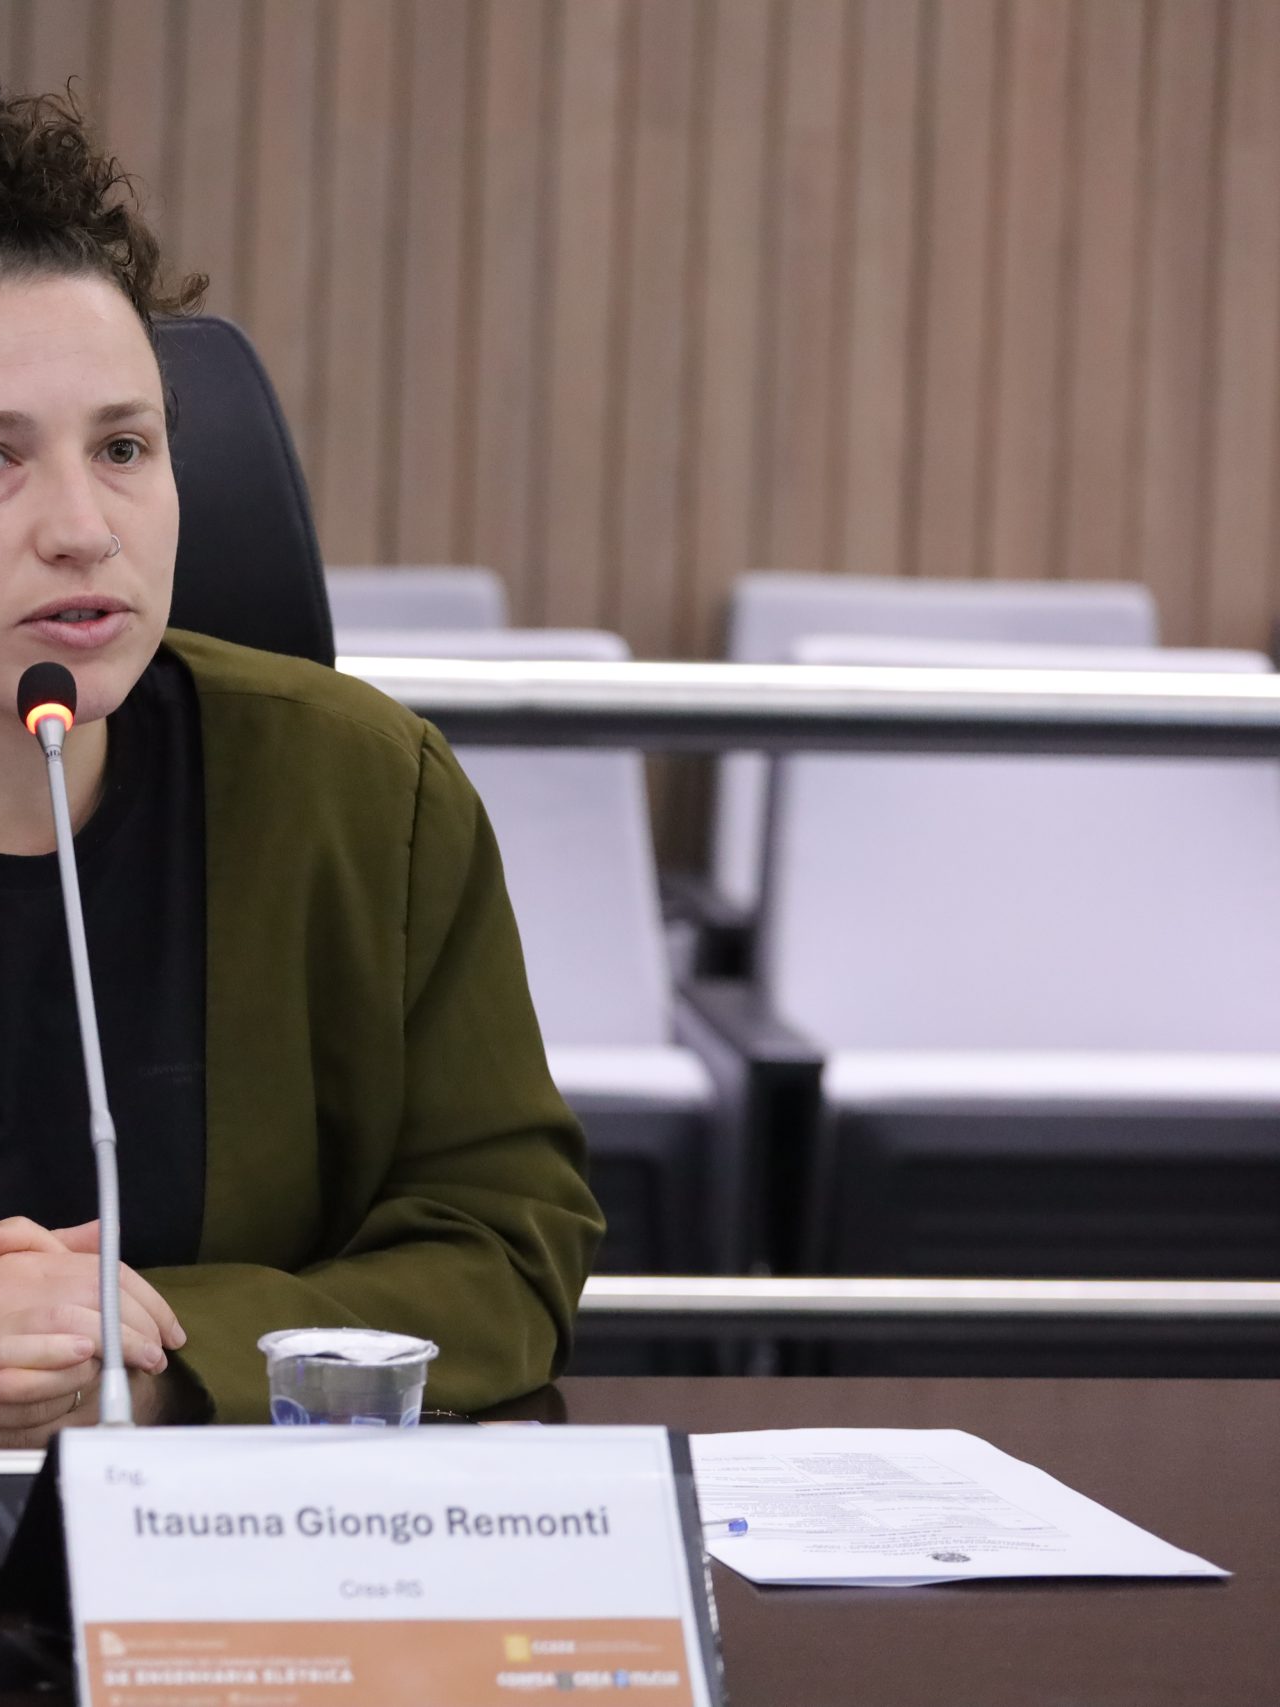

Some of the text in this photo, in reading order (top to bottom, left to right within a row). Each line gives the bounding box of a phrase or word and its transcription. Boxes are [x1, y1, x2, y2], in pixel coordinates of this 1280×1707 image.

[133, 1505, 610, 1545] Itauana Giongo Remonti
[339, 1579, 424, 1599] Crea-RS
